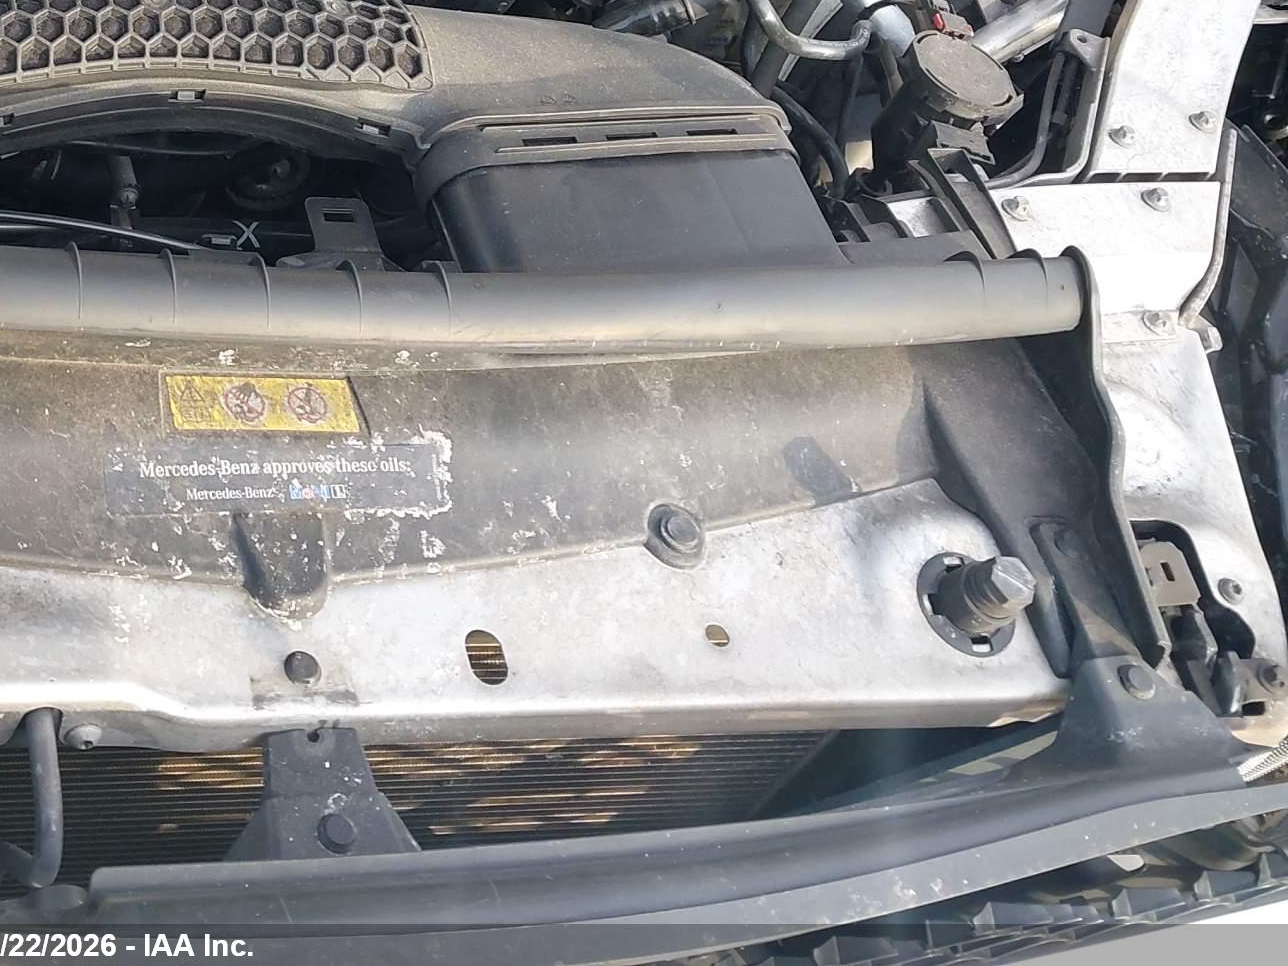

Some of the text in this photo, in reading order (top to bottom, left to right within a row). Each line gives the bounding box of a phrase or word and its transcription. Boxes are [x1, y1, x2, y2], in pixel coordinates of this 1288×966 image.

[140, 457, 411, 478] Mercedes-Benz approves these oils:
[186, 486, 274, 501] Mercedes-Benz
